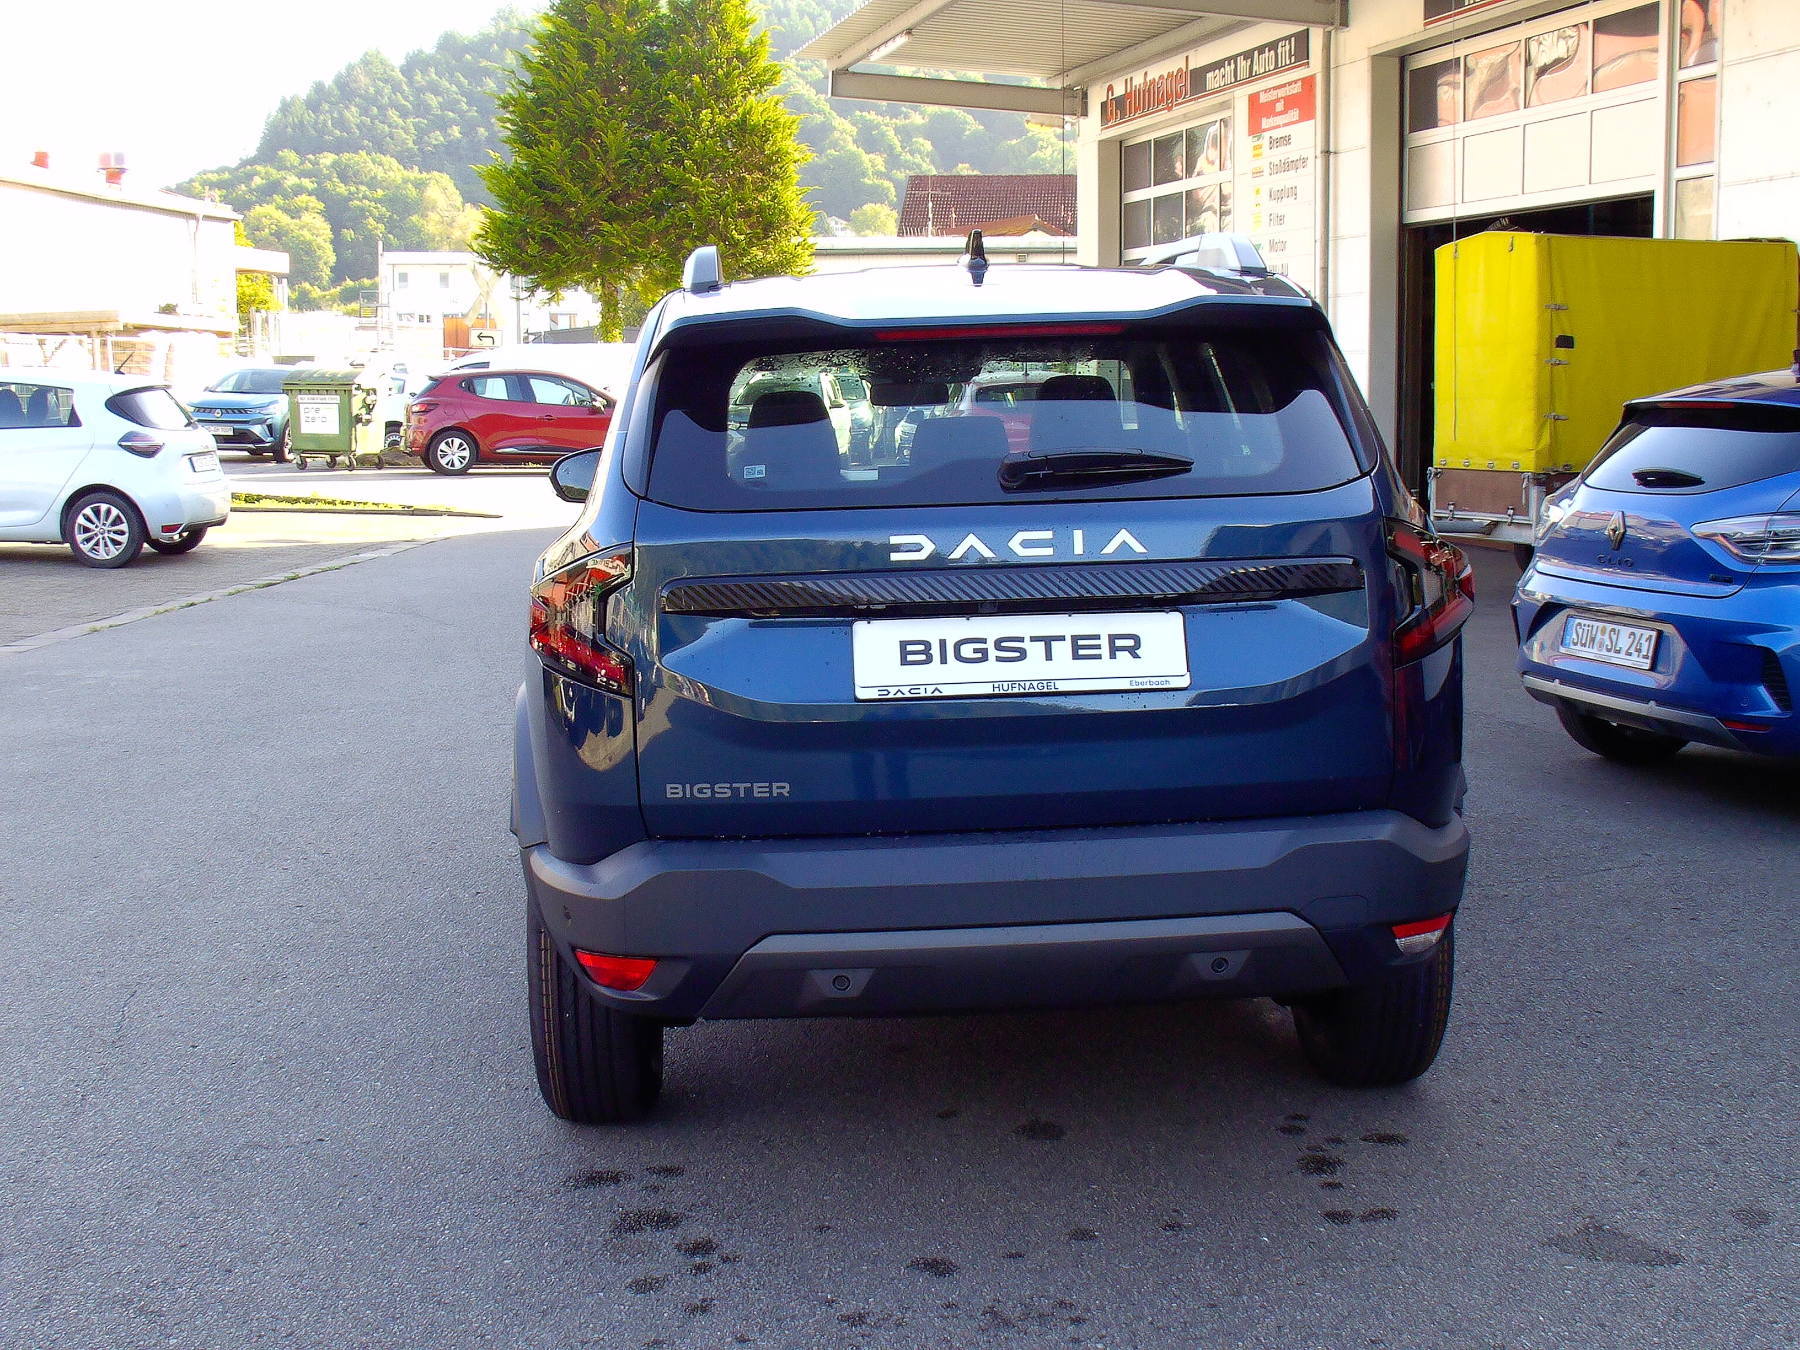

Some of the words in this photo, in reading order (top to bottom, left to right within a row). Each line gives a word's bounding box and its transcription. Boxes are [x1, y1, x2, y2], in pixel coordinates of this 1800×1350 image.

[1206, 59, 1235, 91] macht
[1237, 55, 1252, 80] Ihr
[1252, 47, 1276, 76] Auto
[1278, 37, 1296, 68] fit!
[1124, 54, 1190, 118] Hufnagel
[1269, 134, 1292, 150] Bremse
[1269, 155, 1309, 176] Stoßdämpfer
[1269, 185, 1298, 204] Kupplung
[1269, 212, 1286, 227] Filter
[1269, 239, 1287, 253] Motor
[889, 528, 1149, 562] DACIA
[1595, 553, 1635, 569] CLIO
[899, 633, 1142, 666] BIGSTER
[1606, 627, 1622, 654] SL
[1624, 631, 1653, 660] 241
[877, 686, 943, 697] DACIA
[992, 681, 1059, 693] HUFNAGEL
[1129, 679, 1171, 687] Eberbach
[665, 782, 791, 799] BIGSTER
